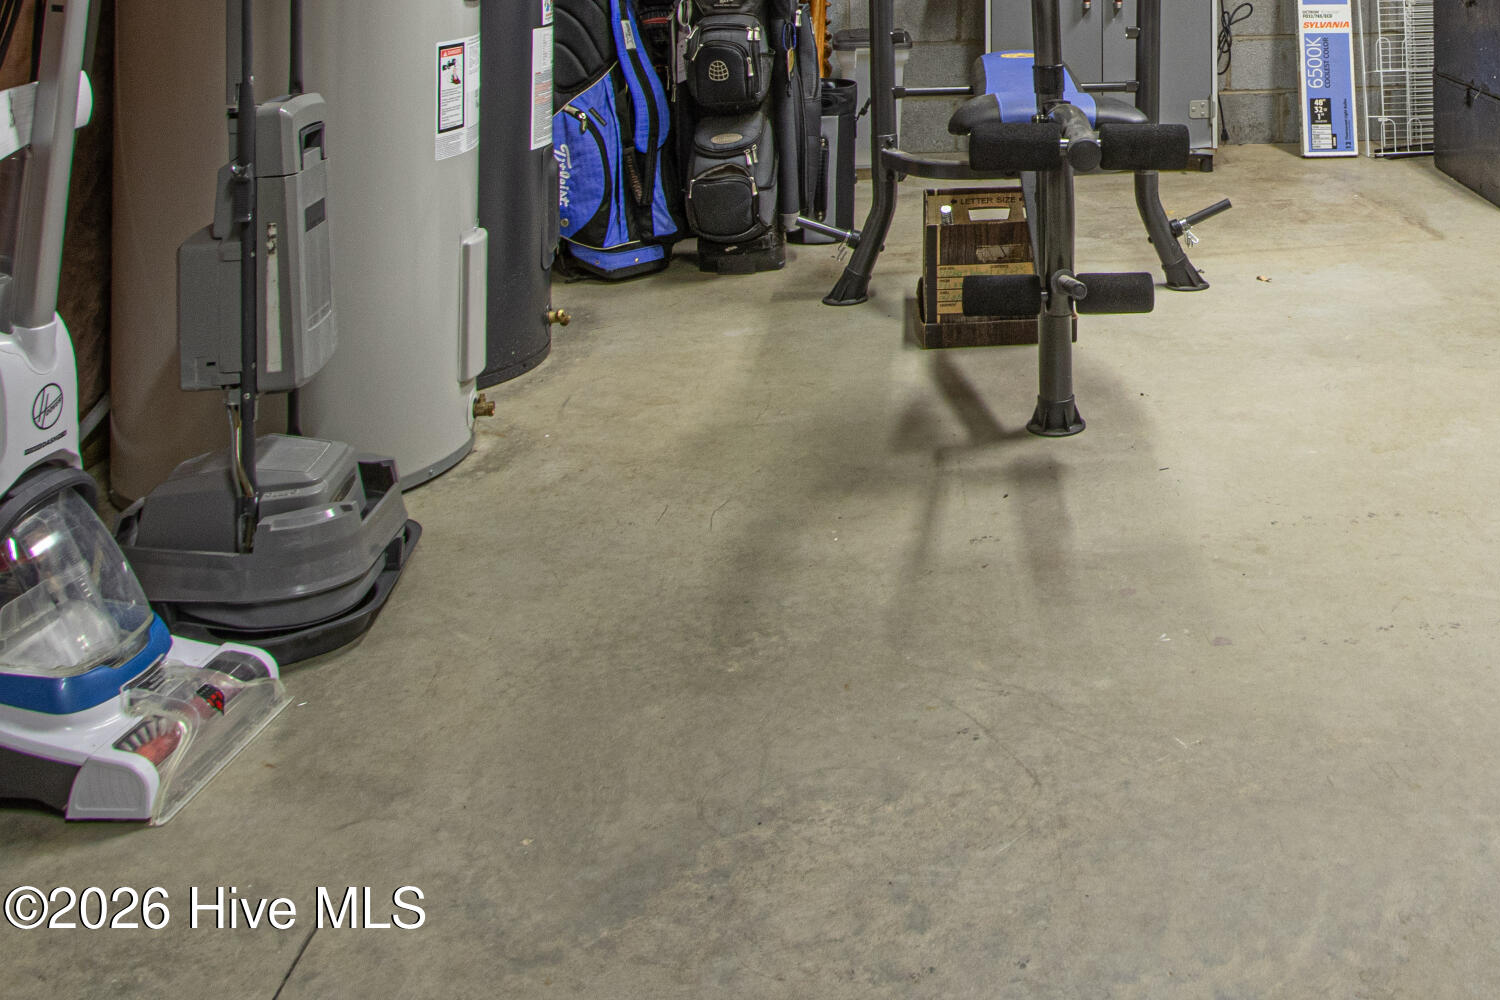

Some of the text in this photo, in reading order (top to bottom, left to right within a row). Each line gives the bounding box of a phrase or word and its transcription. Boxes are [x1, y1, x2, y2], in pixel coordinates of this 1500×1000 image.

[1303, 21, 1350, 29] SYLVANIA
[1306, 36, 1323, 88] 6500K
[960, 197, 993, 205] LETTER
